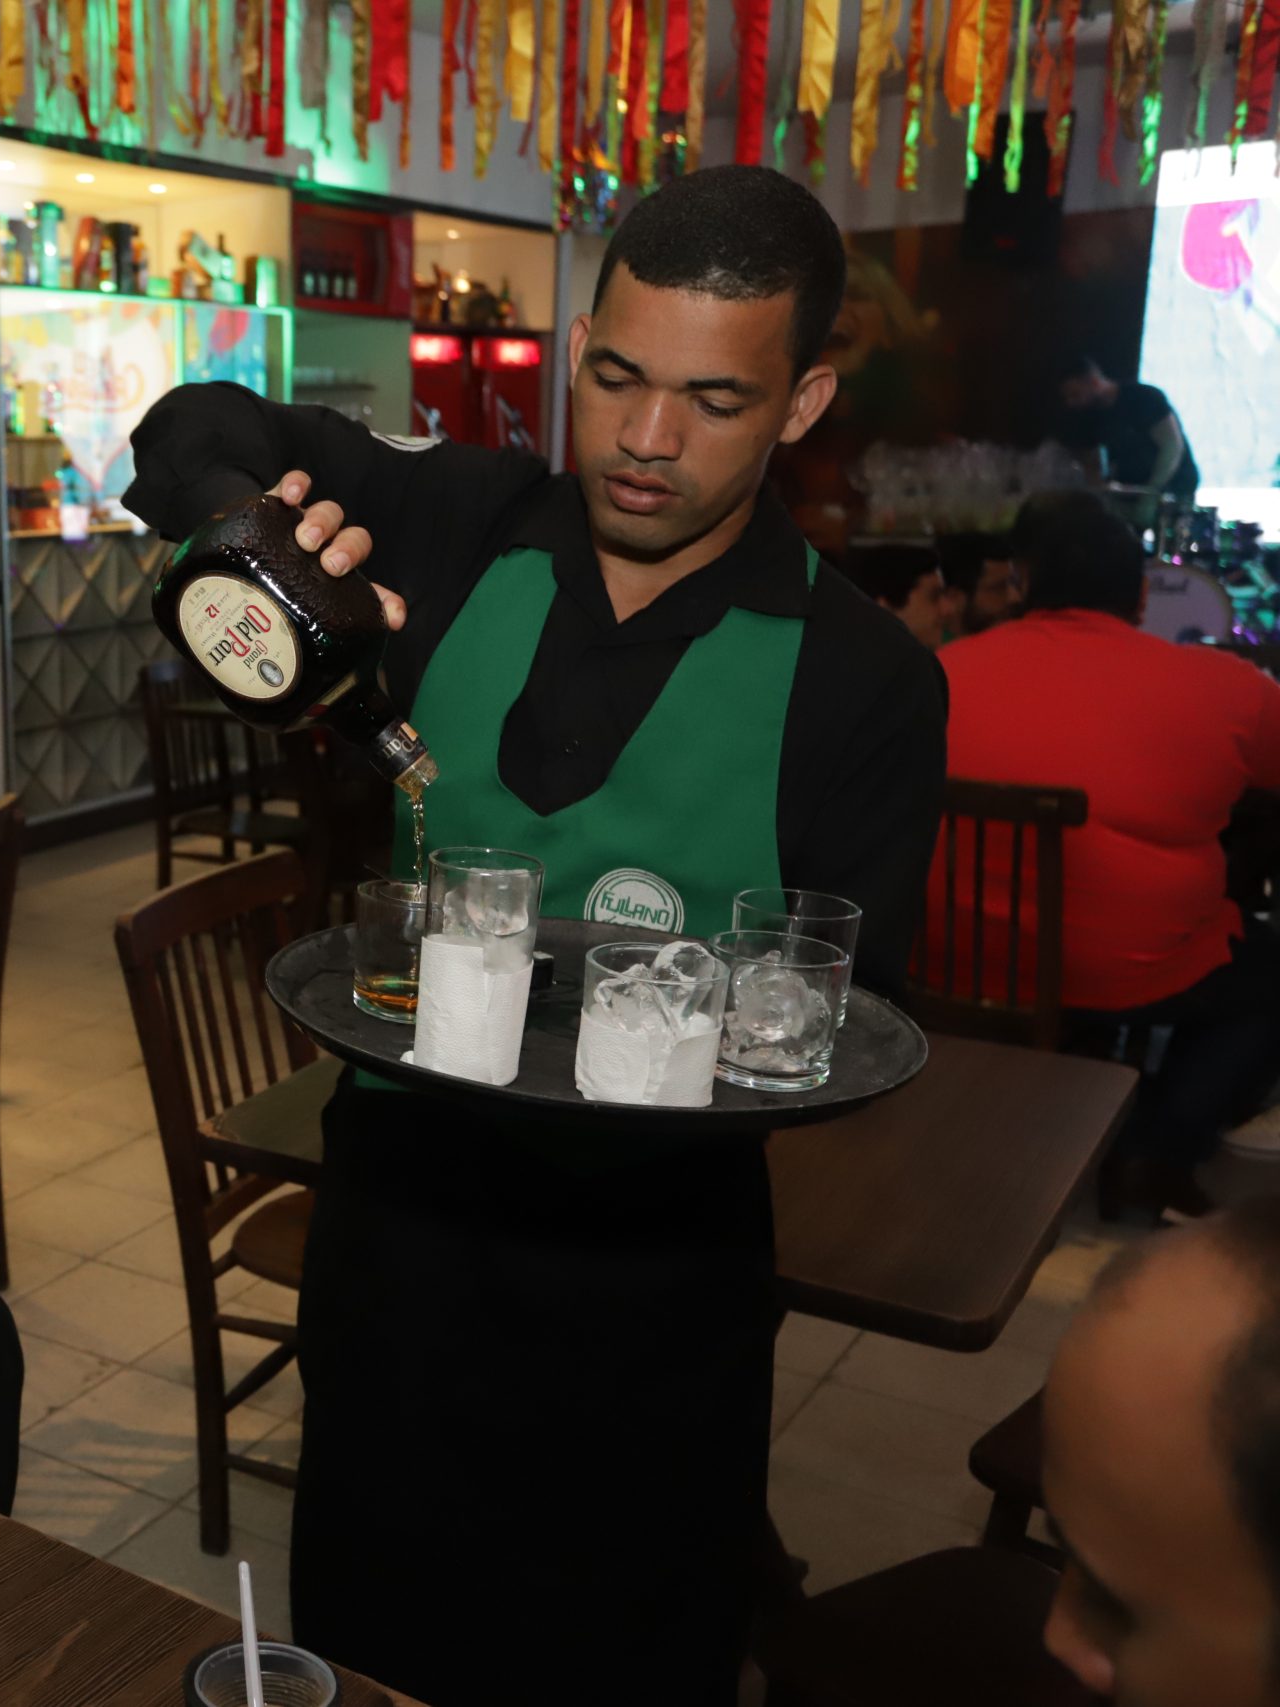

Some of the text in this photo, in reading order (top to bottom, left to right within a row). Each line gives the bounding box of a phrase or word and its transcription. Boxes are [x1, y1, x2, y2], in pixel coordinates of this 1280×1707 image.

[204, 603, 220, 619] 12
[234, 604, 271, 643] Old
[206, 626, 251, 667] Parr
[243, 639, 268, 670] Grand
[382, 728, 416, 759] Parr
